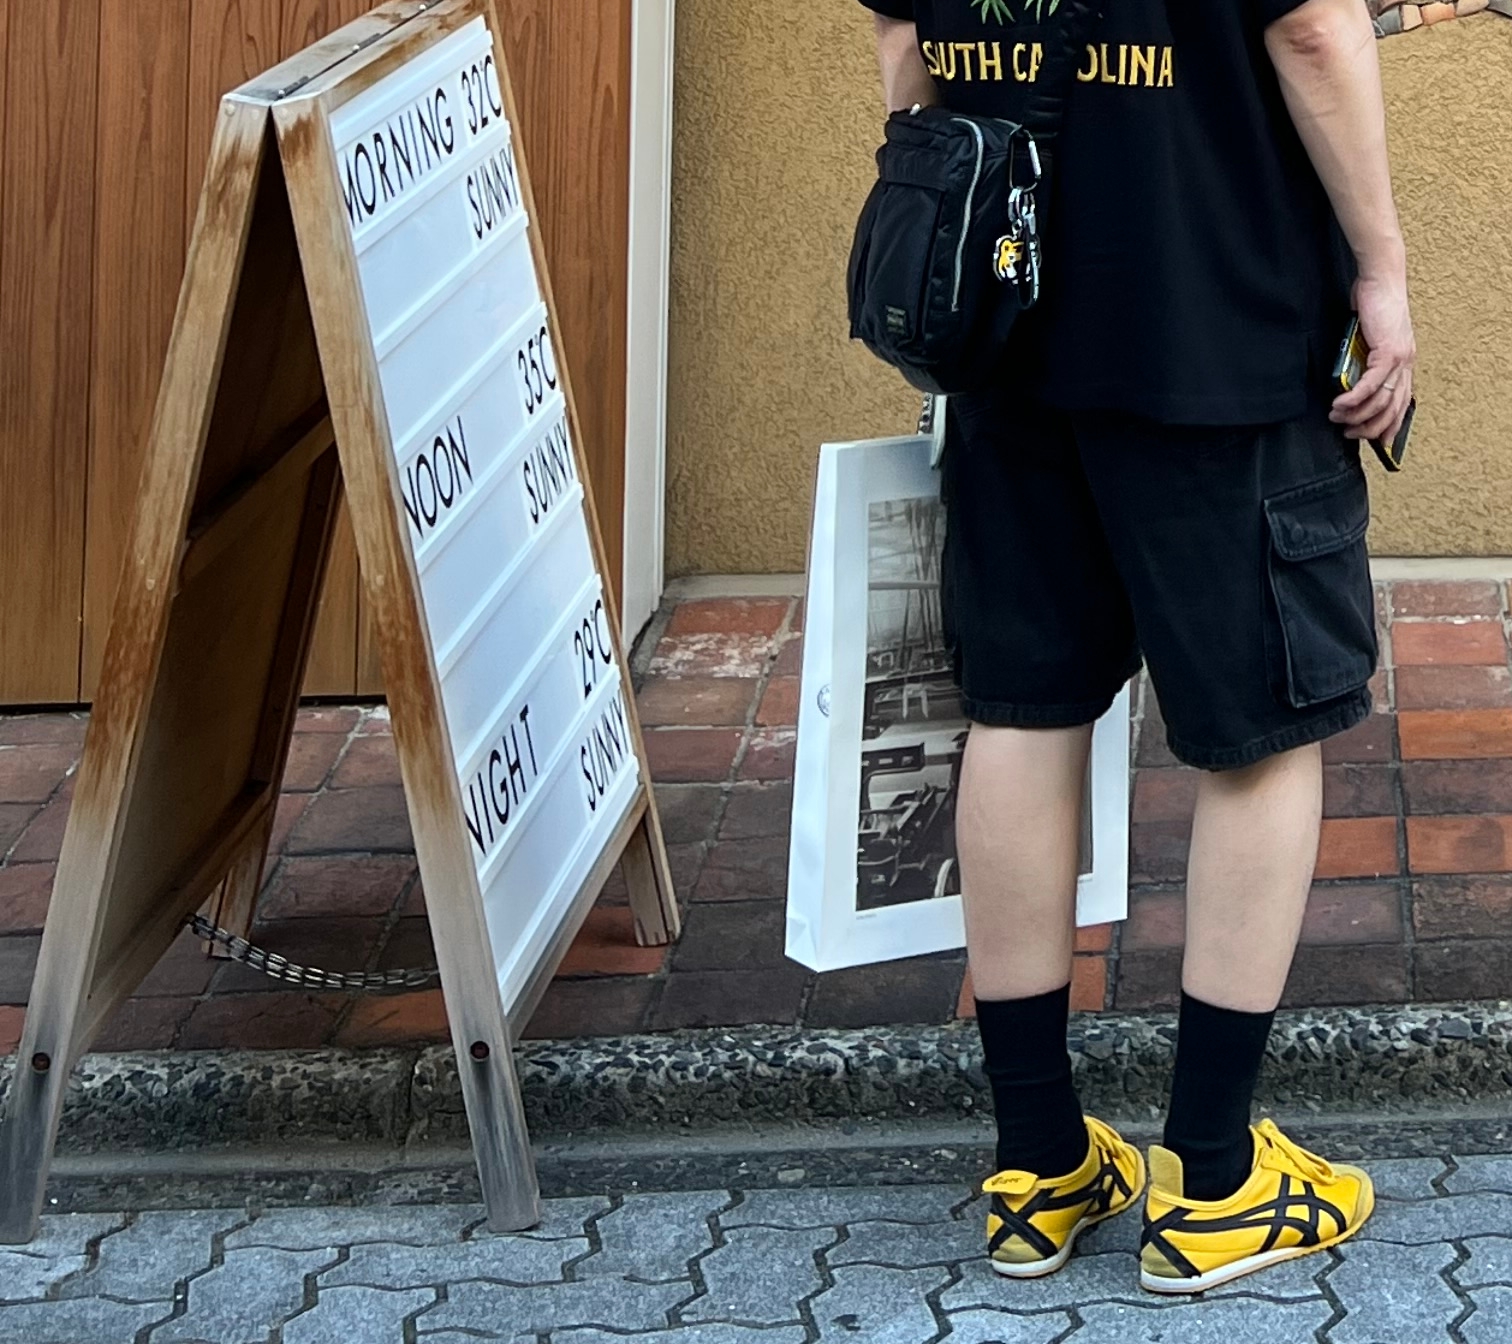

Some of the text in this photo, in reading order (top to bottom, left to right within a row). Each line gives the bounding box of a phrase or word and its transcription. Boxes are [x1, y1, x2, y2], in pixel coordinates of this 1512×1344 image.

[922, 40, 1174, 88] SUTH CAOLINA
[467, 143, 519, 240] SUNNY
[523, 415, 574, 525] SUNNY
[580, 689, 630, 812] SUNNY
